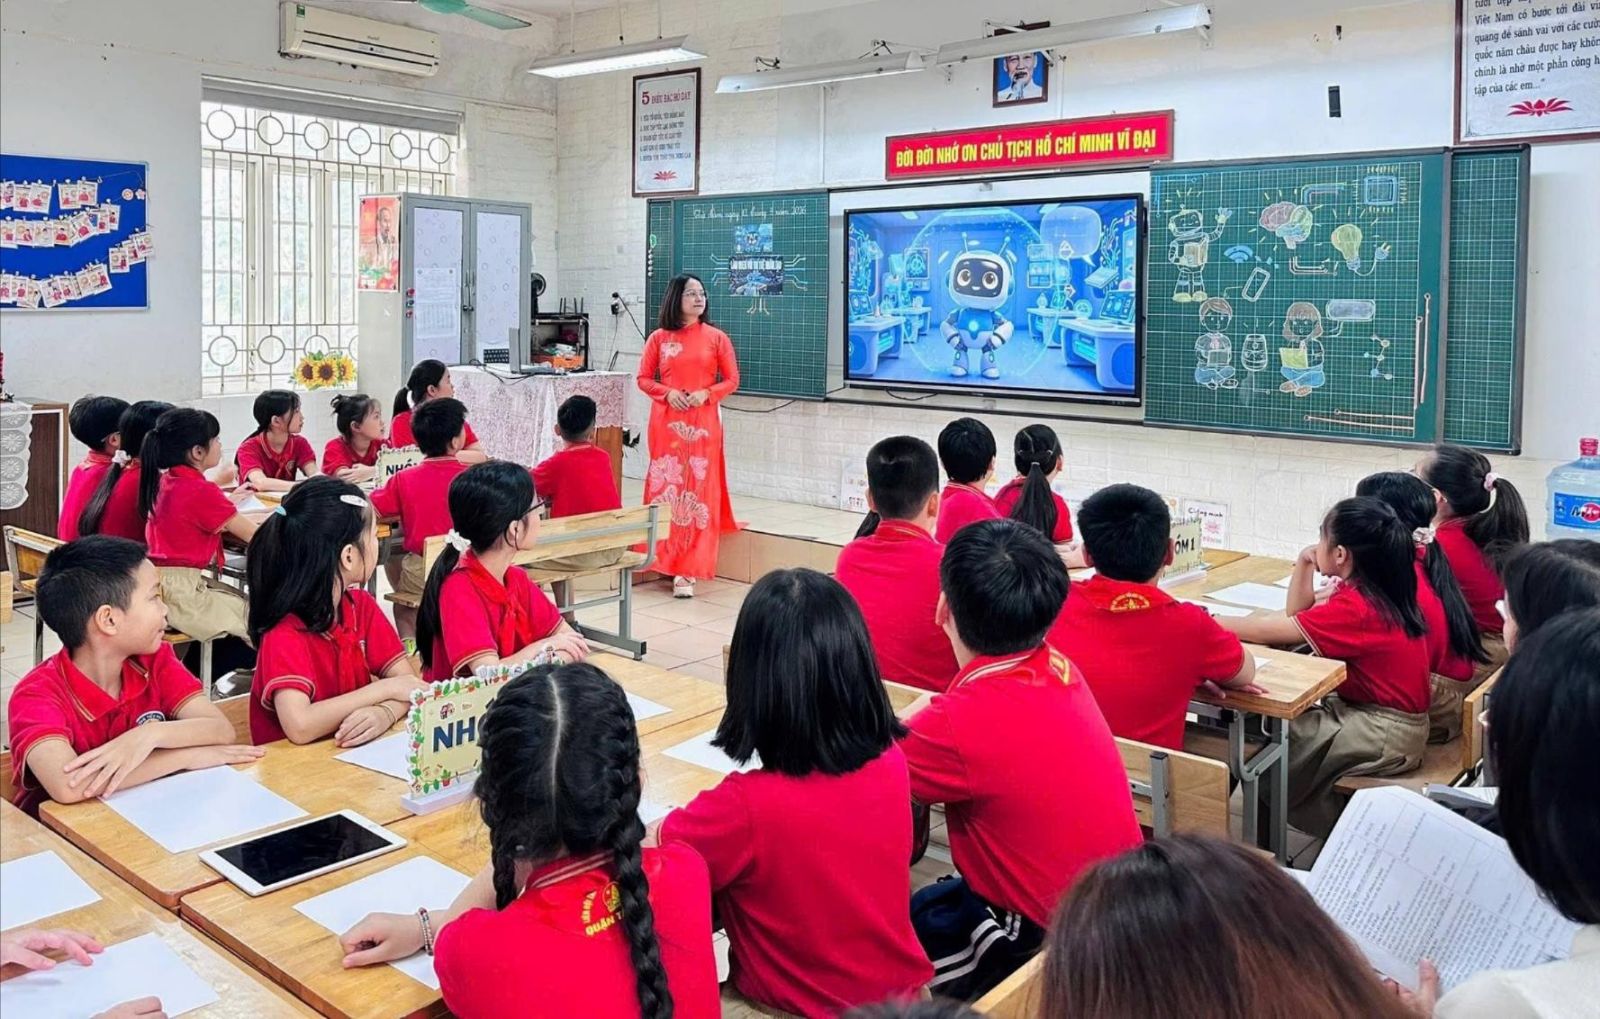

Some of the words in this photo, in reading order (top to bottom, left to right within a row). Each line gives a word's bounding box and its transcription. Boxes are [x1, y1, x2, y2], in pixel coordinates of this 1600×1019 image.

[1475, 14, 1490, 25] Việt
[1495, 13, 1514, 22] Nam
[1518, 9, 1527, 20] có
[1532, 6, 1552, 18] bước
[1556, 3, 1568, 14] tới
[1572, 2, 1585, 13] đài
[1475, 33, 1499, 45] quang
[1501, 25, 1512, 39] để
[1514, 27, 1533, 38] sánh
[1535, 27, 1549, 35] vai
[1551, 22, 1564, 33] với
[1567, 21, 1580, 31] các
[1475, 46, 1493, 62] quốc
[1496, 47, 1513, 57] năm
[1516, 43, 1536, 55] châu
[1538, 42, 1559, 54] được
[1561, 40, 1577, 51] hay
[1580, 36, 1600, 48] khôn
[1474, 66, 1496, 77] chính
[1499, 64, 1507, 75] là
[1509, 63, 1525, 74] nhờ
[1528, 60, 1544, 73] một
[1547, 55, 1568, 72] phần
[1571, 56, 1591, 69] công
[642, 91, 650, 106] 5
[1474, 84, 1487, 96] tập
[1489, 82, 1503, 93] của
[1505, 80, 1518, 91] các
[896, 146, 913, 168] ĐỜI
[916, 144, 934, 166] ĐỜI
[937, 141, 959, 164] NHỚ
[962, 144, 977, 162] ƠN
[981, 135, 1003, 160] CHỦ
[1006, 139, 1032, 162] TỊCH
[1035, 132, 1052, 157] HỒ
[1055, 132, 1076, 155] CHÍ
[1079, 132, 1113, 153] MINH
[1117, 127, 1130, 150] VĨ
[1133, 129, 1156, 152] ĐẠI
[1174, 534, 1189, 555] ÓM
[1190, 537, 1195, 551] 1
[433, 713, 478, 753] NH
